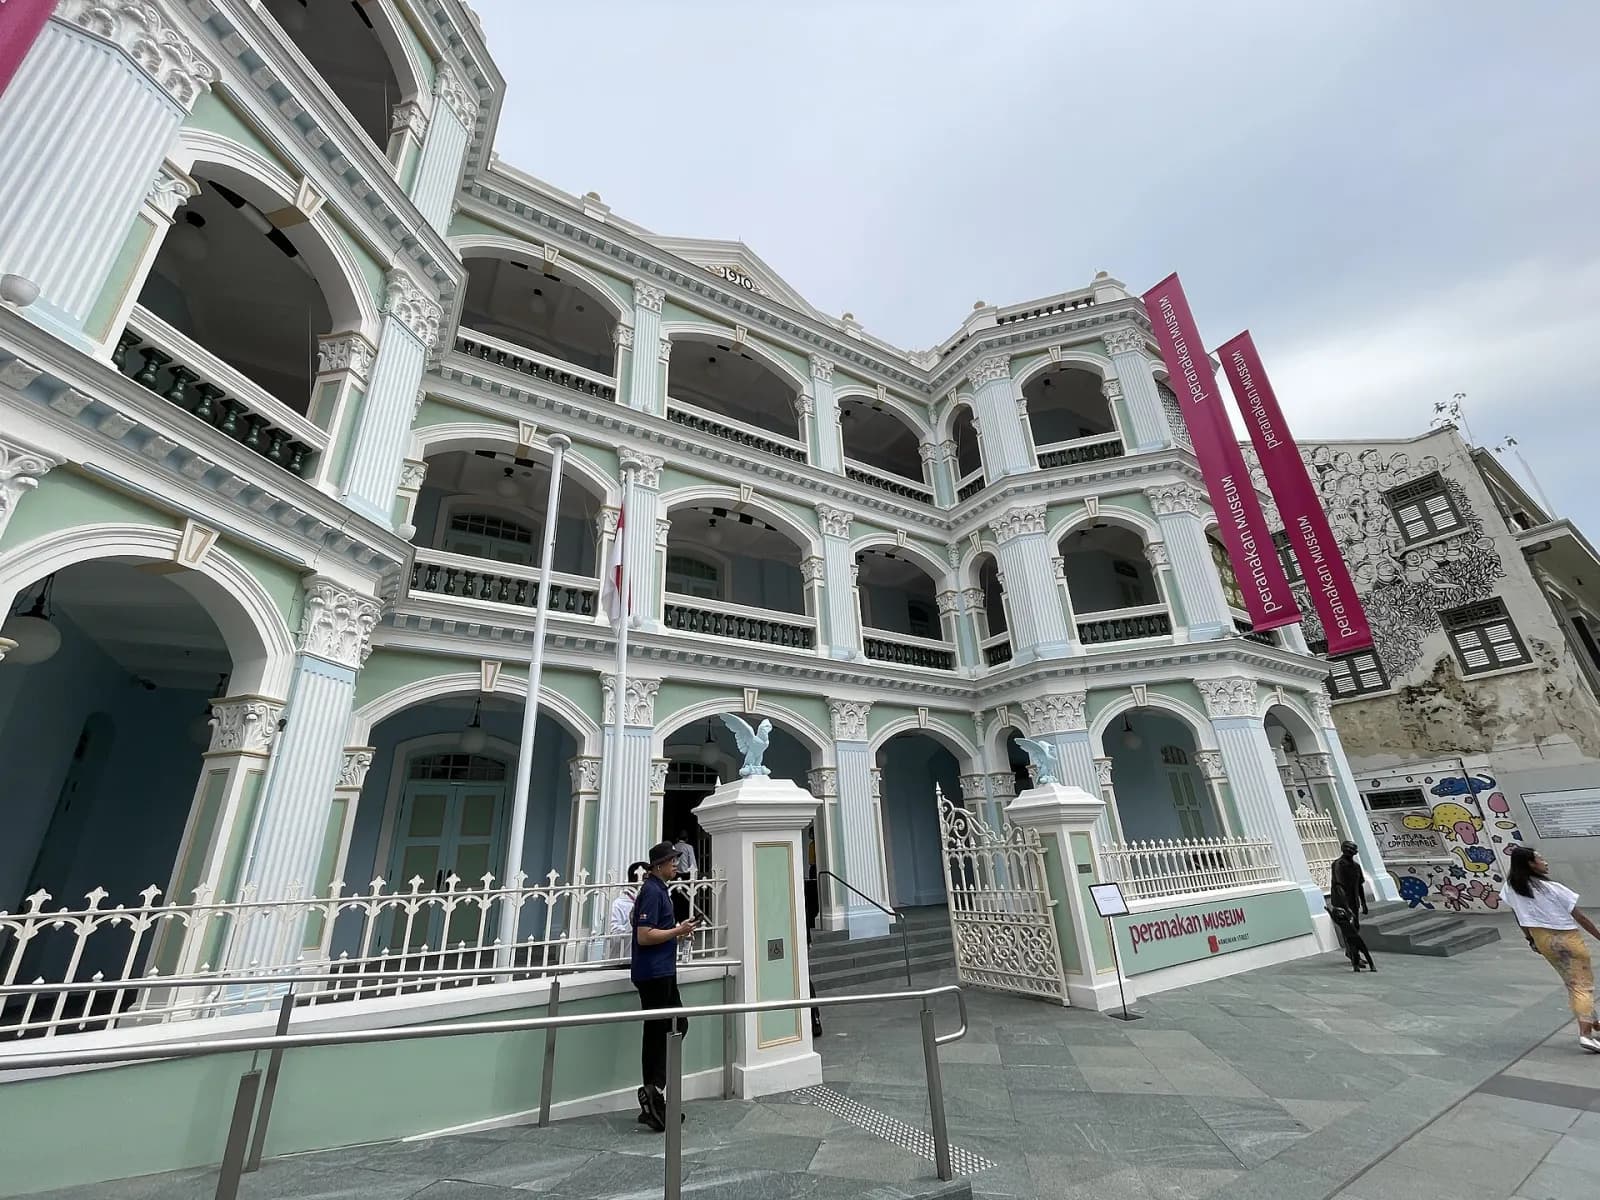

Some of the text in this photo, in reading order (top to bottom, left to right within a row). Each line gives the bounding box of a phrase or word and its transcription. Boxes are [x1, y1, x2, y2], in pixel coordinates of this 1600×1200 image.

[720, 266, 753, 290] 1910
[1159, 295, 1209, 404] peranakan MUSEUM
[1232, 349, 1283, 450] peranakan MUSEUM
[1221, 475, 1283, 614] peranakan MUSEUM
[1297, 515, 1358, 638] peranakan MUSEUM
[1128, 907, 1246, 954] peranakan MUSEUM
